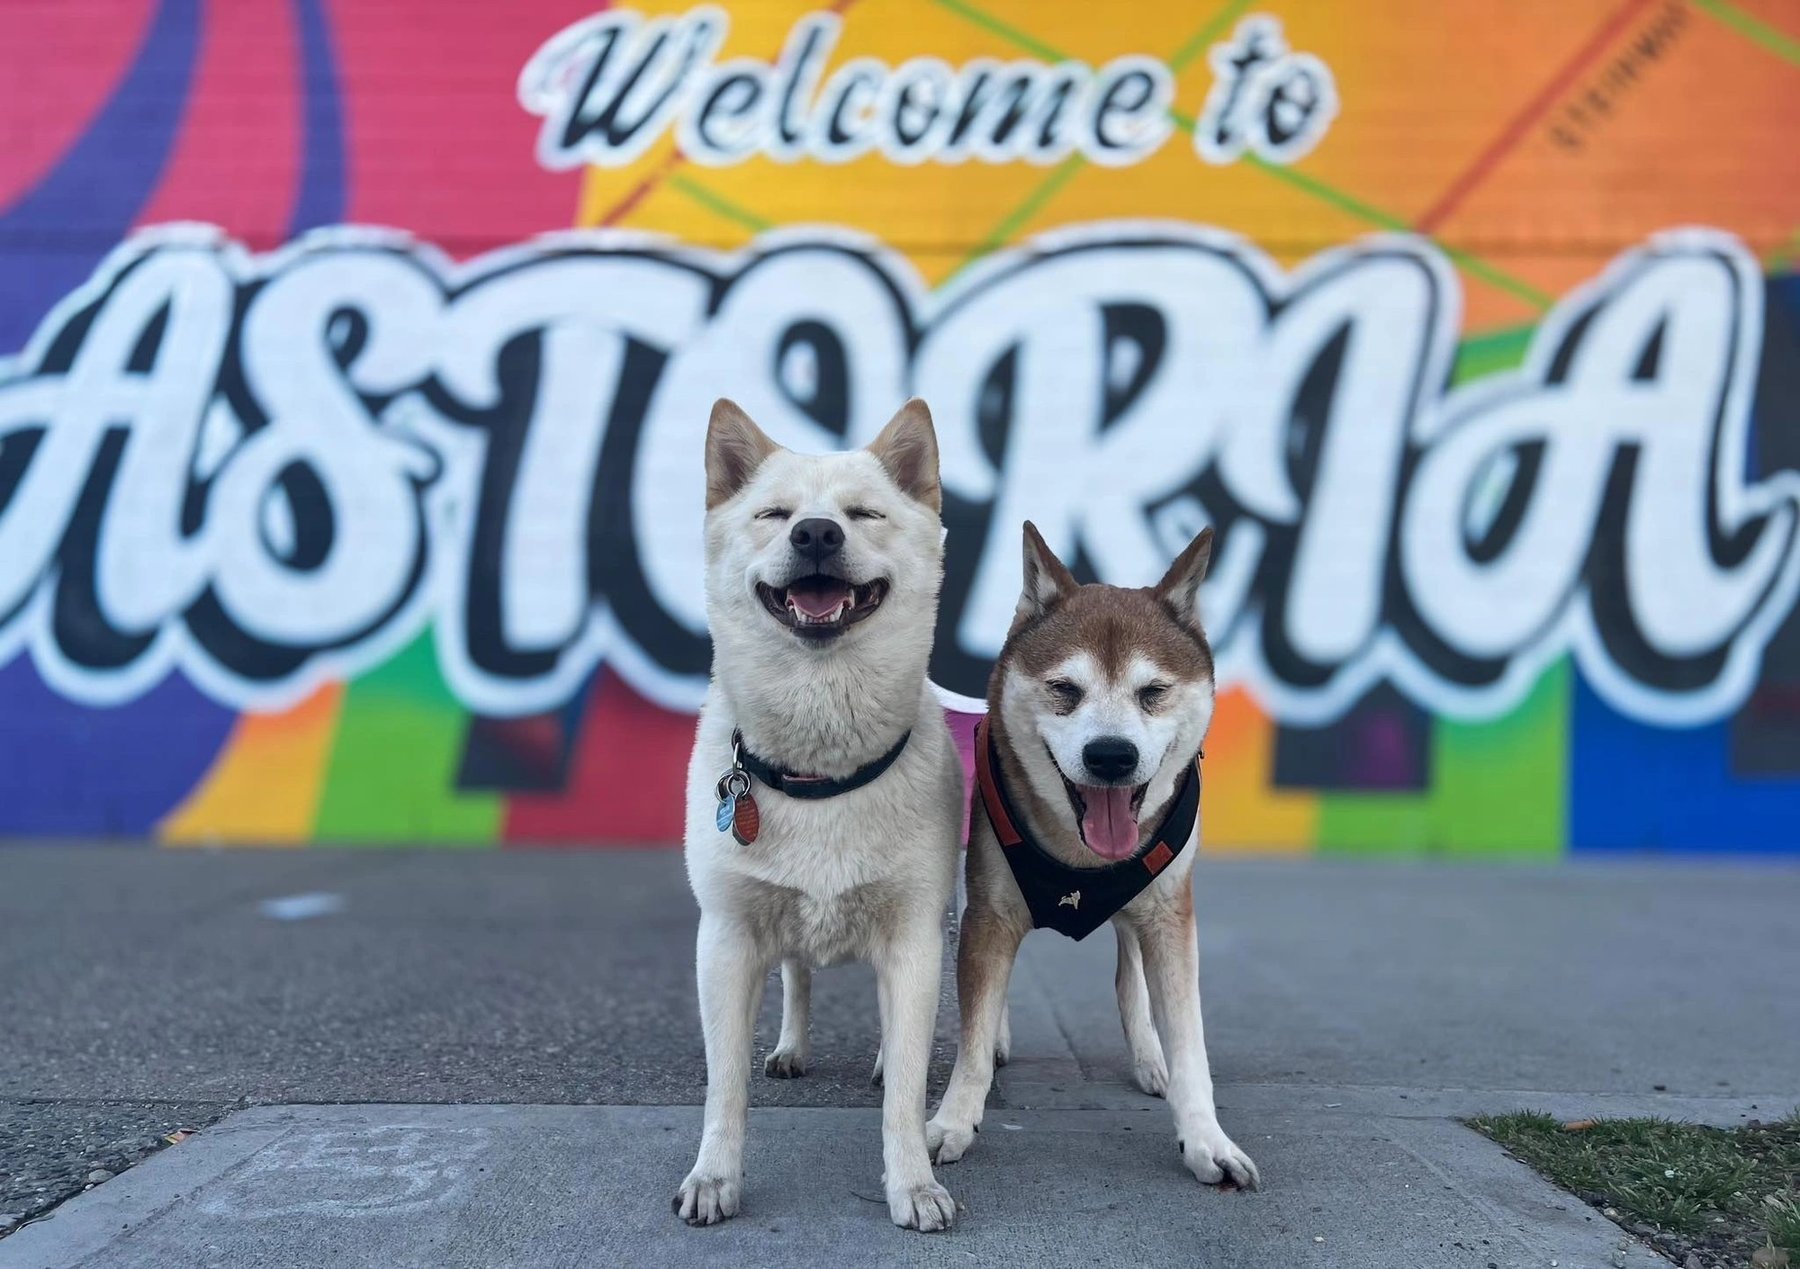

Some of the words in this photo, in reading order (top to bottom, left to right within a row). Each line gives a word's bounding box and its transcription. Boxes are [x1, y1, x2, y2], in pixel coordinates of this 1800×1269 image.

[526, 13, 1164, 158] Welcome
[1202, 20, 1332, 157] to
[0, 226, 1800, 718] ASTORIA
